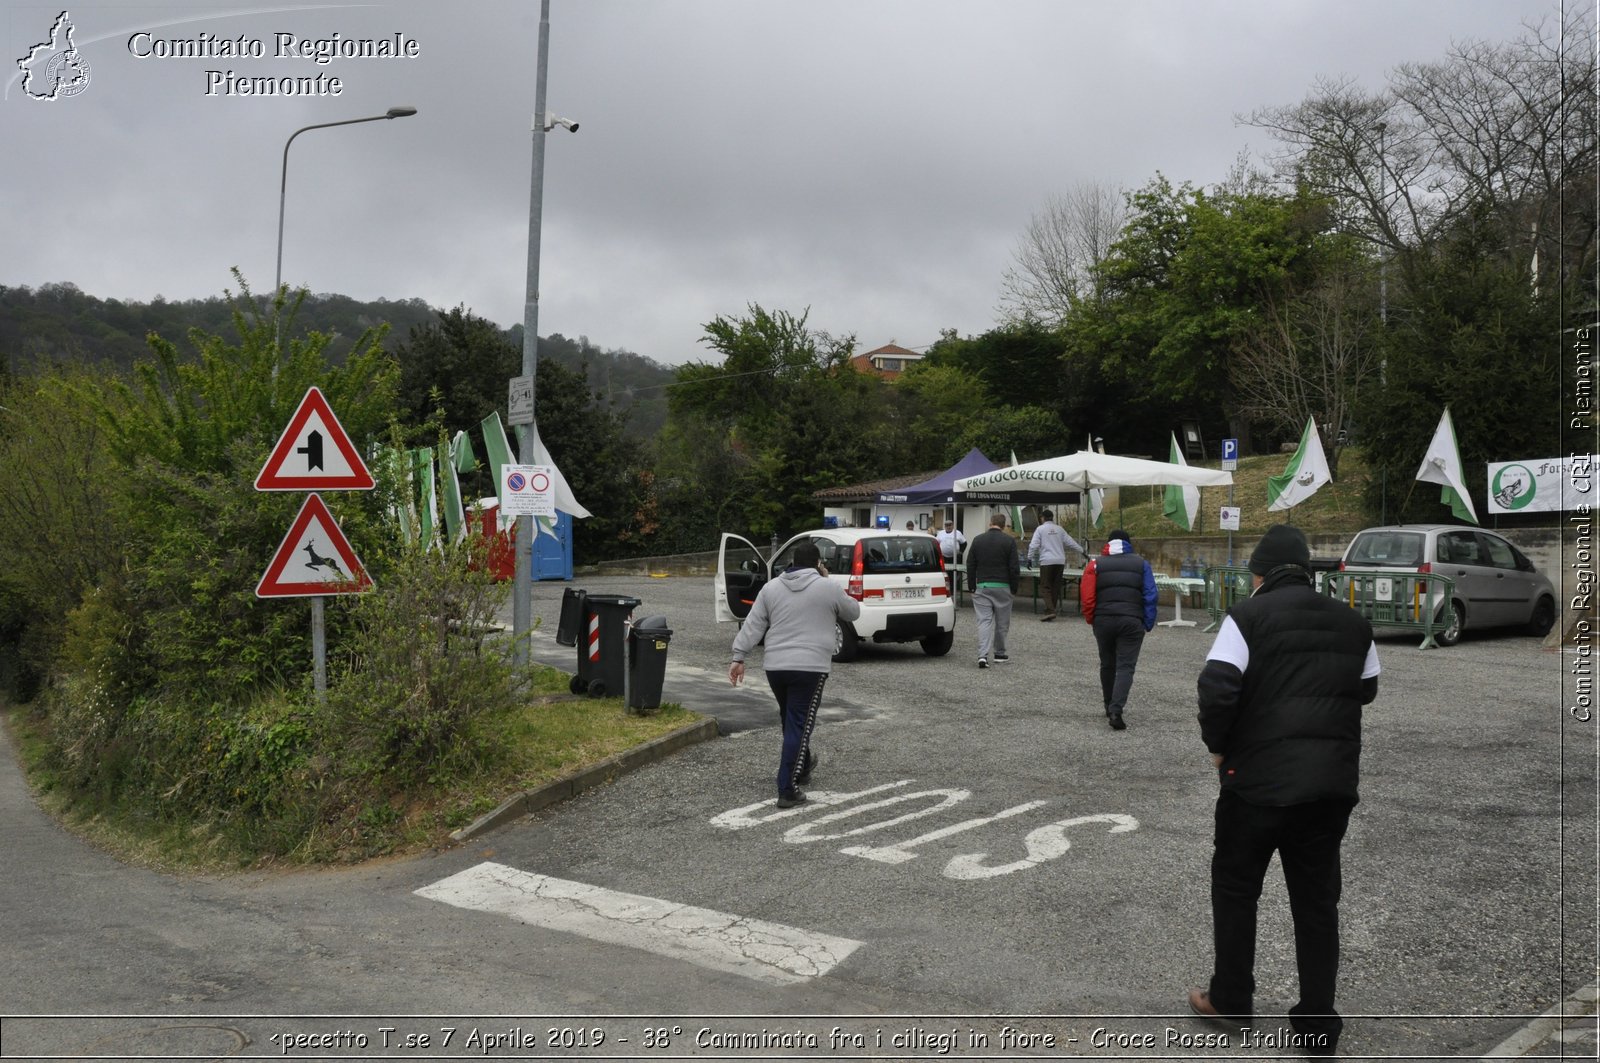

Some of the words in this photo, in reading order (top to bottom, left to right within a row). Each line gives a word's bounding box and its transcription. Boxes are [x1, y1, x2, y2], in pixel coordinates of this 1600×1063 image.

[1224, 441, 1235, 458] P
[966, 477, 986, 489] PRO
[989, 469, 1018, 484] LOCO
[1020, 469, 1065, 482] PECETTO
[709, 779, 1140, 880] STOP
